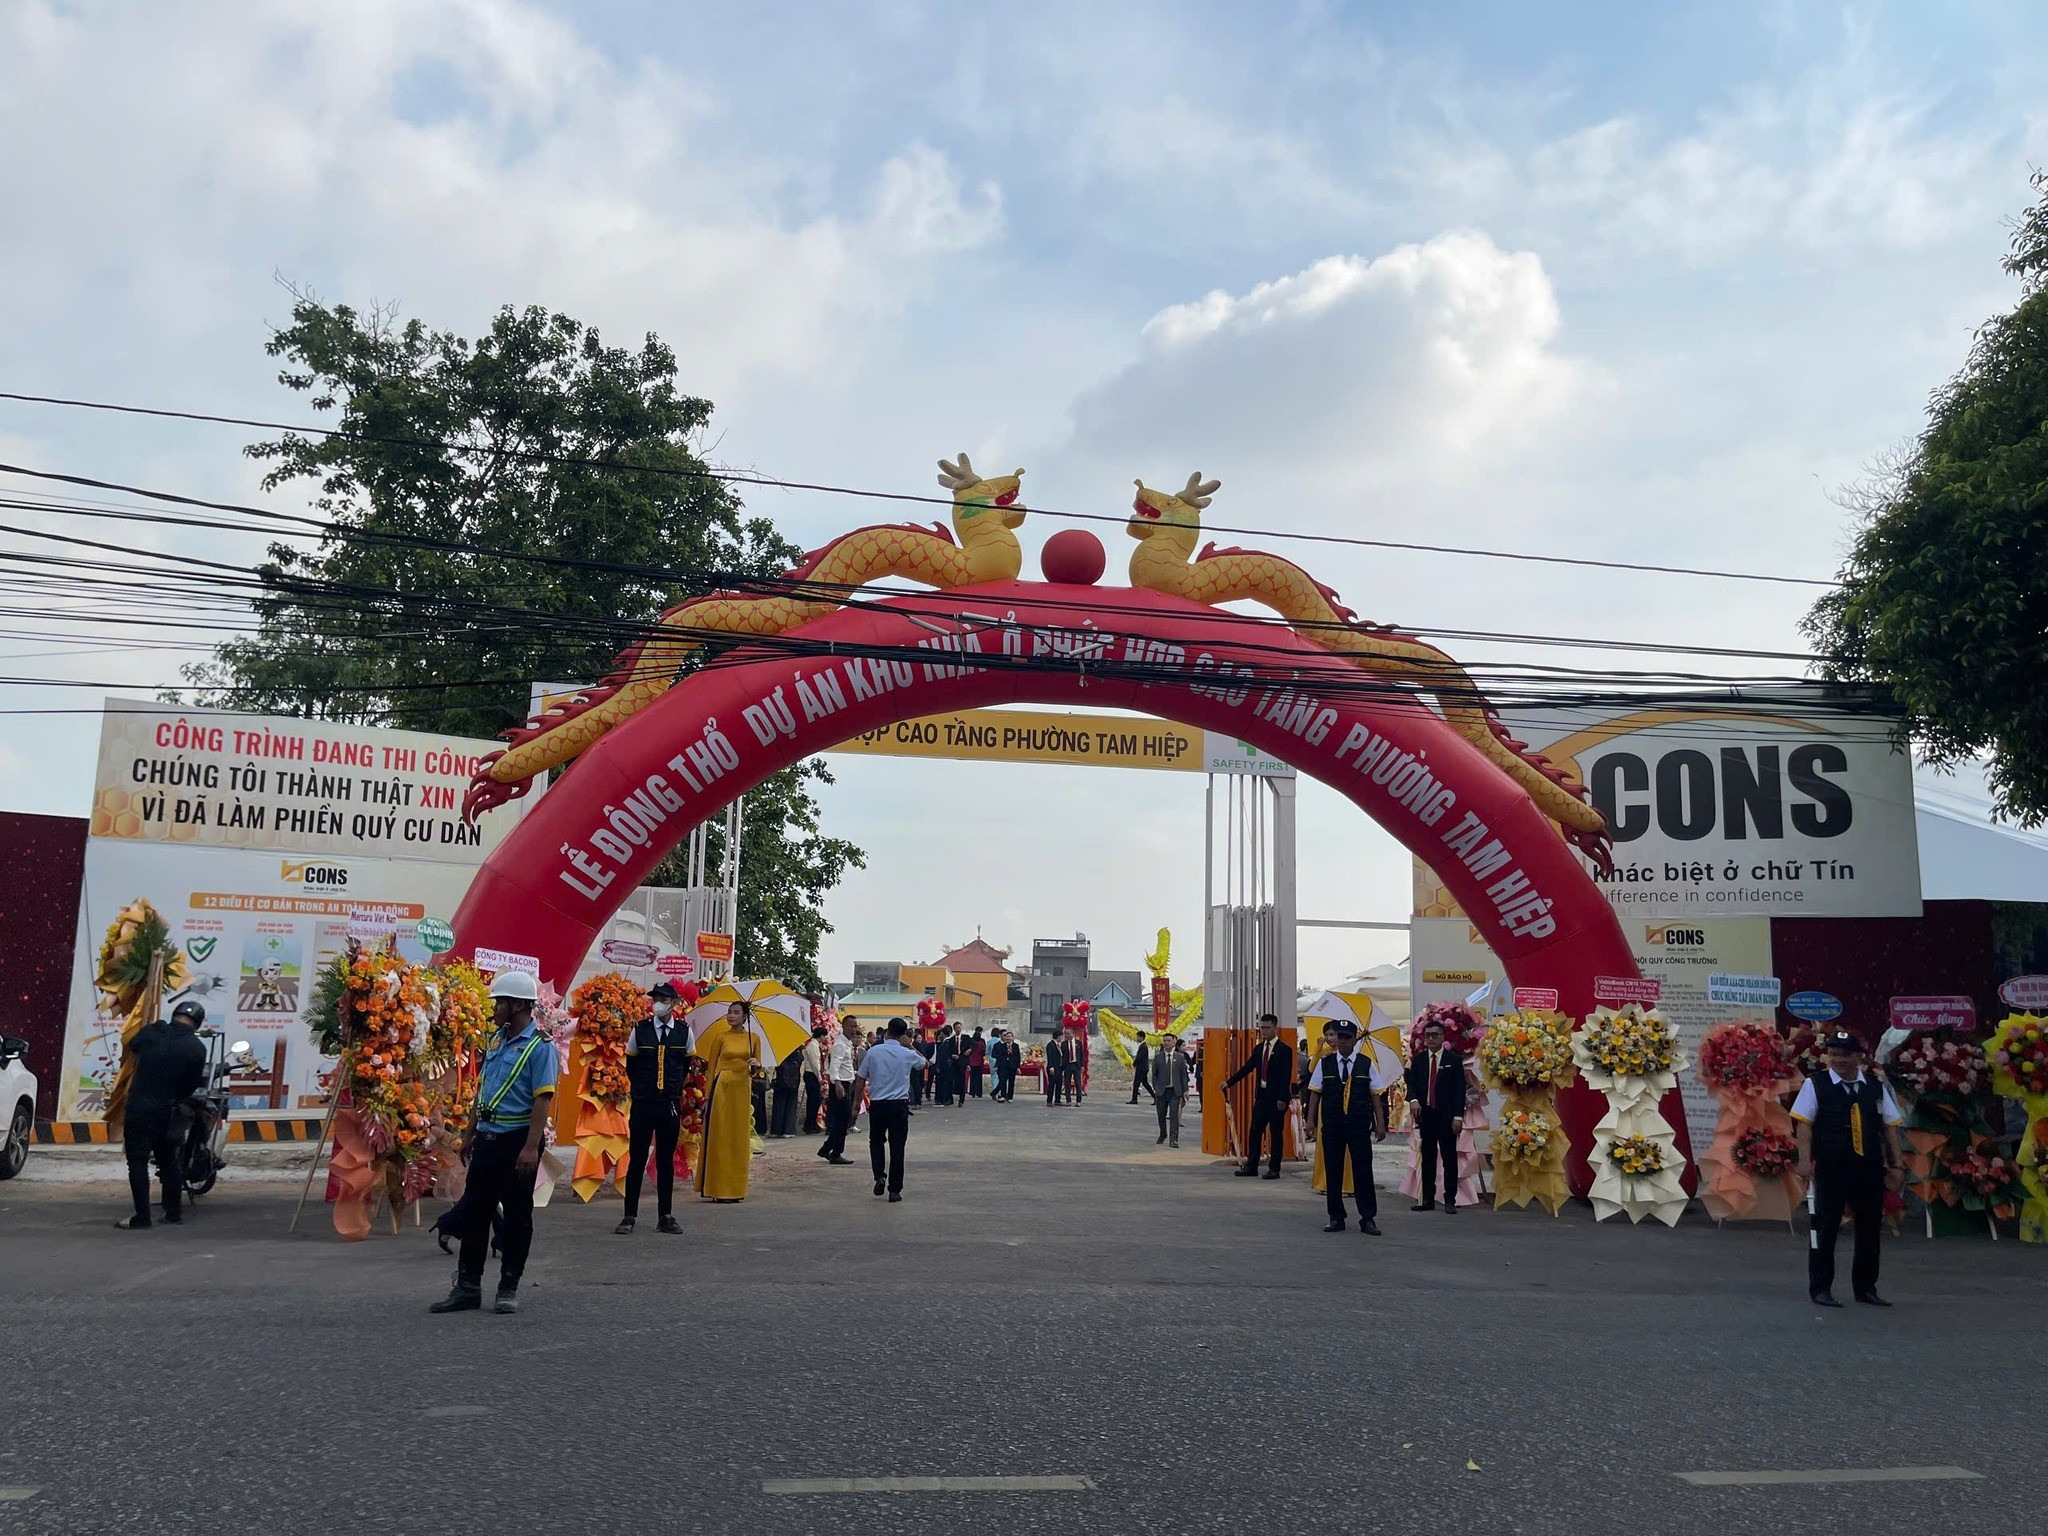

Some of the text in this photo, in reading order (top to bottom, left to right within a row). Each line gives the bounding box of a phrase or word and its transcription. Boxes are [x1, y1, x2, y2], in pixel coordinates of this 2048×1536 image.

[156, 717, 480, 778] CÔNG TRÌNH ĐANG THI CÔNG
[896, 722, 938, 745] CAO
[944, 717, 997, 747] TẦNG
[1003, 725, 1090, 754] PHƯỜNG
[1096, 733, 1137, 755] TAM
[1143, 731, 1189, 762] HIỆP
[1213, 758, 1289, 772] SAFETY FIRST
[132, 755, 219, 789] CHÚNG
[229, 761, 266, 793] TÔI
[276, 767, 351, 801] THÀNH
[361, 777, 413, 810] THẬT
[420, 785, 455, 810] XIN
[560, 842, 616, 901] LỄ
[589, 774, 686, 865] ĐỘNG
[667, 716, 740, 794] THỔ
[741, 685, 797, 748] DỰ
[794, 670, 848, 724] ÁN
[843, 650, 914, 702] KHU
[1335, 722, 1457, 828] PHƯỜNG
[1440, 811, 1513, 881] TAM
[1485, 869, 1556, 939] HIỆP
[142, 791, 482, 846] VÌ ĐÃ LÀM PHIỀN QUÝ CƯ DÂN
[1593, 860, 1855, 885] Khác biệt ở chữ Tín
[204, 897, 217, 907] 12
[295, 900, 325, 912] TRONG
[327, 902, 340, 913] AN
[1604, 888, 1804, 903] ifference in confidence
[417, 924, 433, 935] GIA
[475, 949, 538, 968] CÔNG TY BACONS
[1649, 957, 1663, 966] QUY
[1665, 956, 1686, 966] CÔNG
[1435, 972, 1473, 981] MŨ BẢO HỘ
